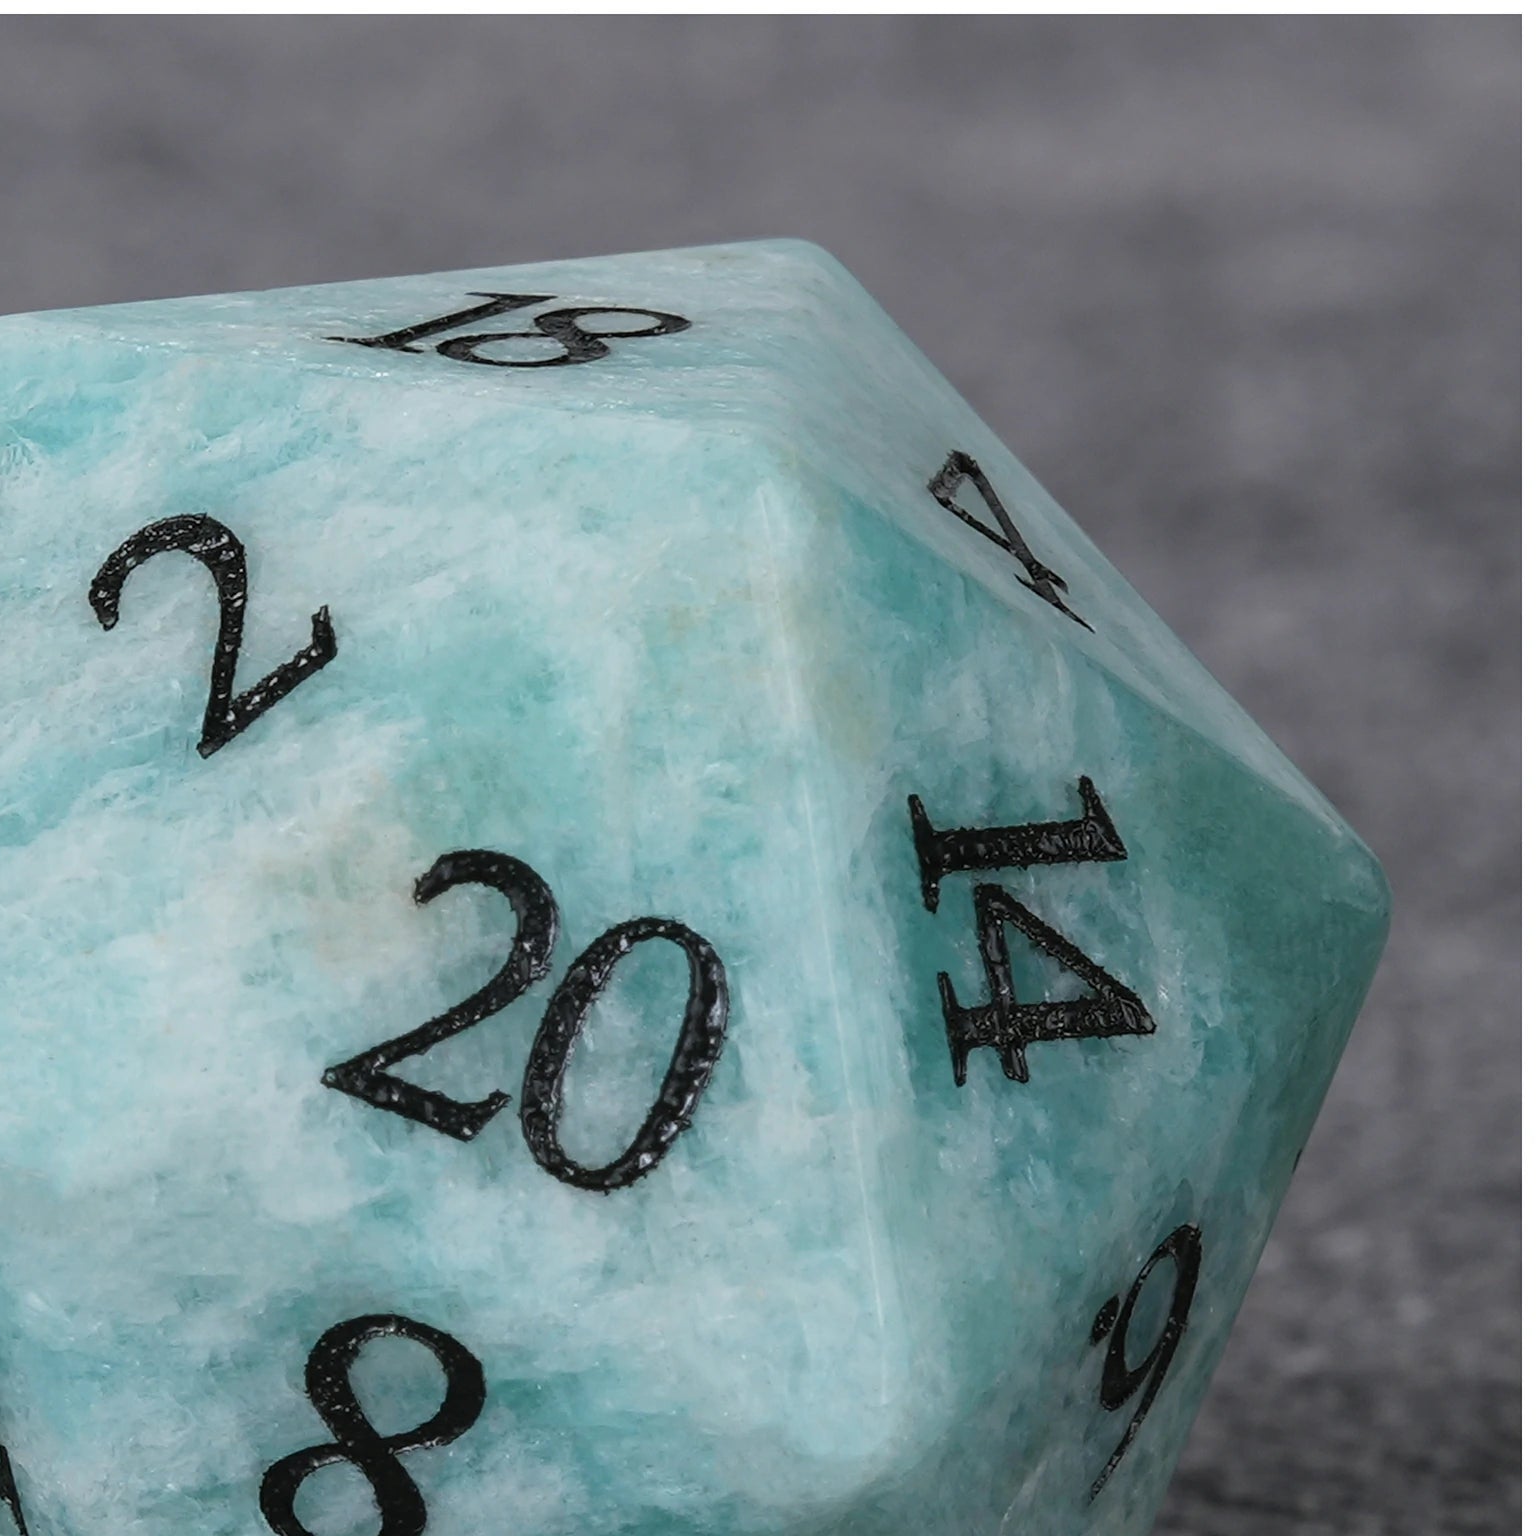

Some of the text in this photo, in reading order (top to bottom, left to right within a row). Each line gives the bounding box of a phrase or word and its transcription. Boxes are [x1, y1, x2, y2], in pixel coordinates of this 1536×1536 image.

[320, 291, 692, 368] 18
[88, 514, 337, 759] 2
[928, 450, 1094, 632] 4
[320, 848, 730, 1195] 20
[909, 777, 1157, 1087] 14
